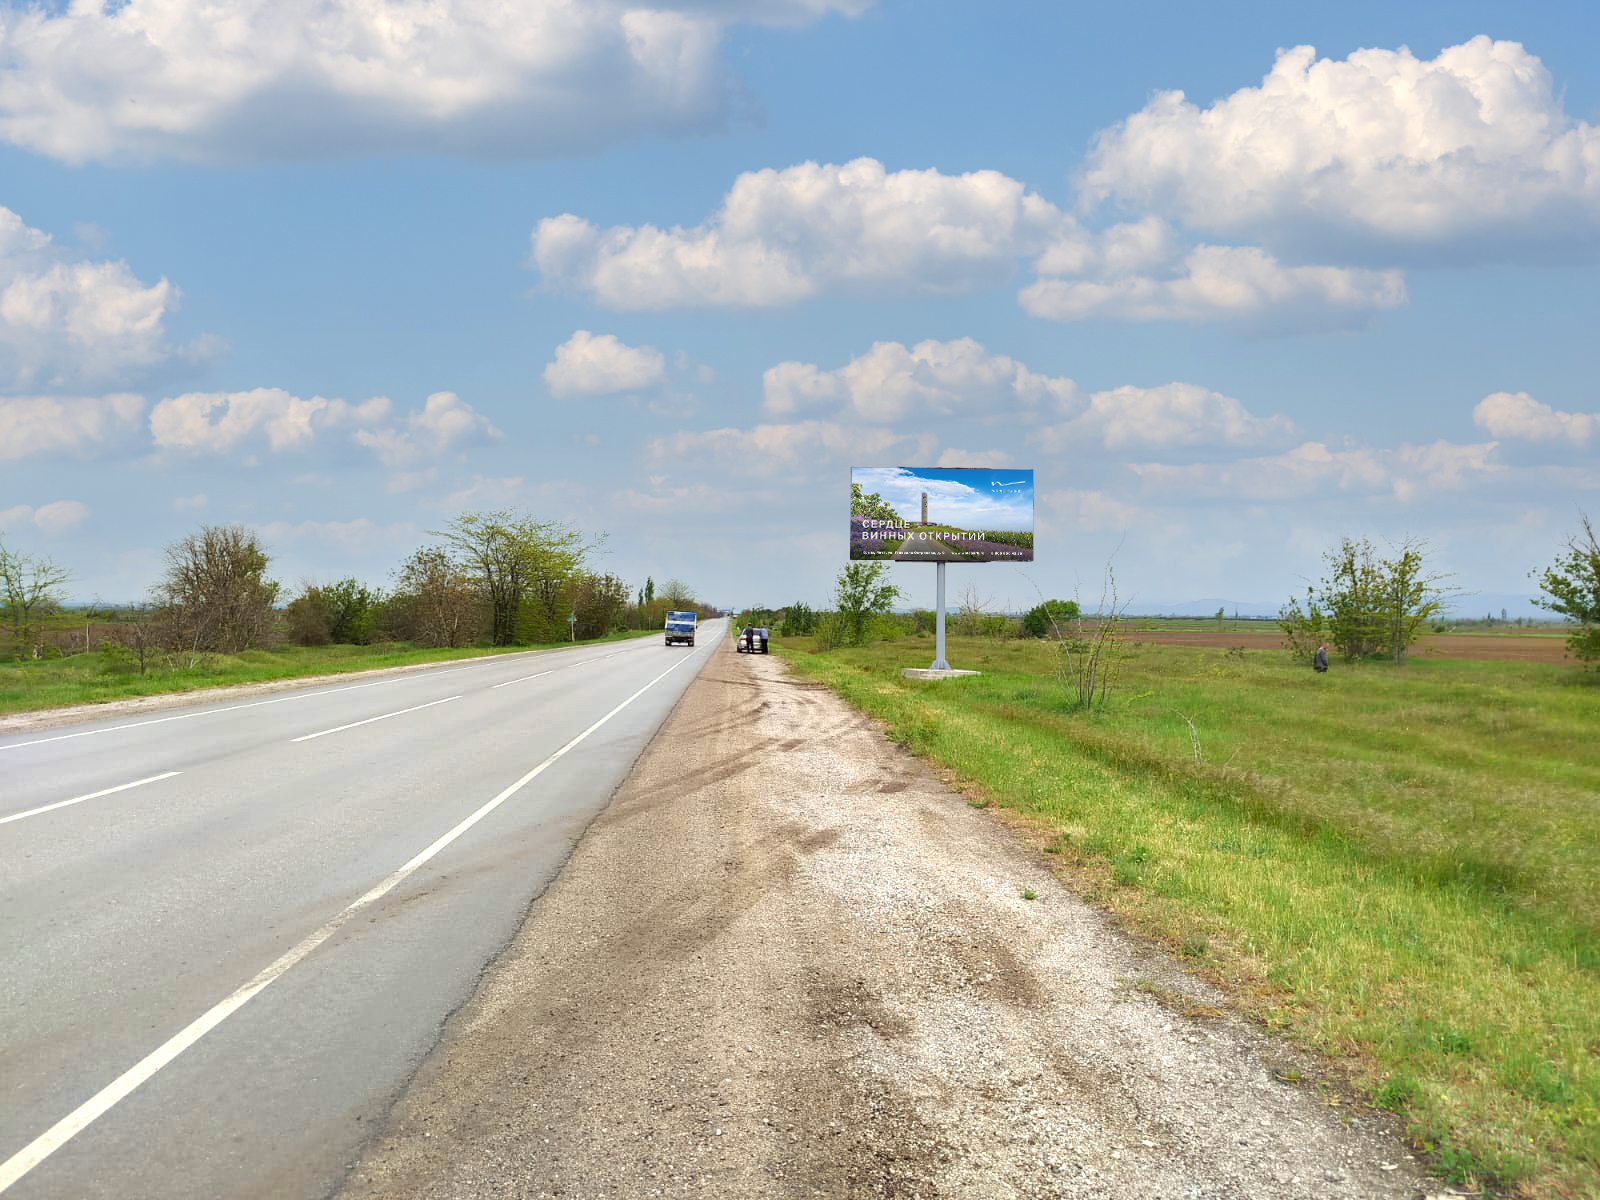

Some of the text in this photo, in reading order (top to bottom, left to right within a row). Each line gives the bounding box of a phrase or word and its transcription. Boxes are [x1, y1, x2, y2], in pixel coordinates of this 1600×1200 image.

[862, 519, 911, 530] СЕРДЦЕ
[862, 530, 986, 541] ВИННЫХ ОТКРЫТИЙ
